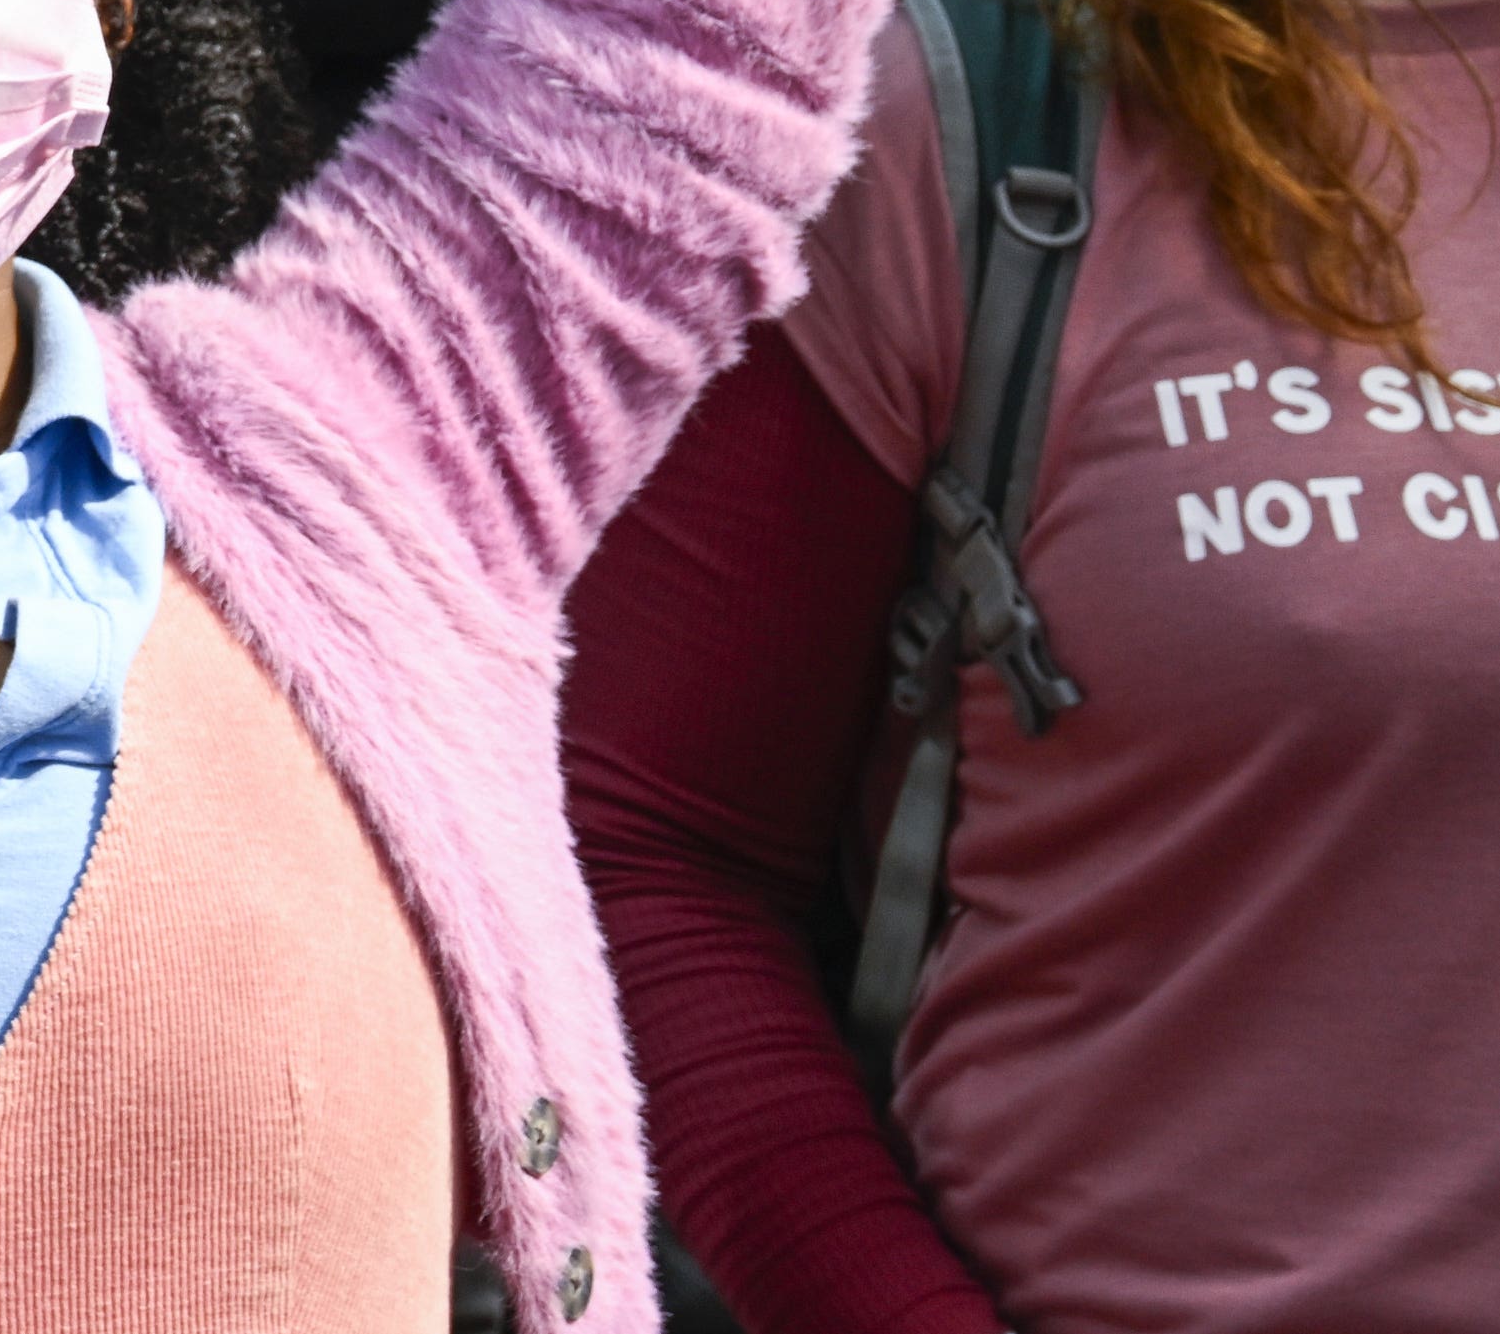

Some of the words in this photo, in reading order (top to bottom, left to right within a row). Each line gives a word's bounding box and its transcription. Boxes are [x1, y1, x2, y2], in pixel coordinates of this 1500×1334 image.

[1155, 359, 1332, 447] IT'S
[1359, 365, 1500, 435] SIS
[1177, 475, 1364, 561] NOT
[1402, 471, 1500, 542] CI
